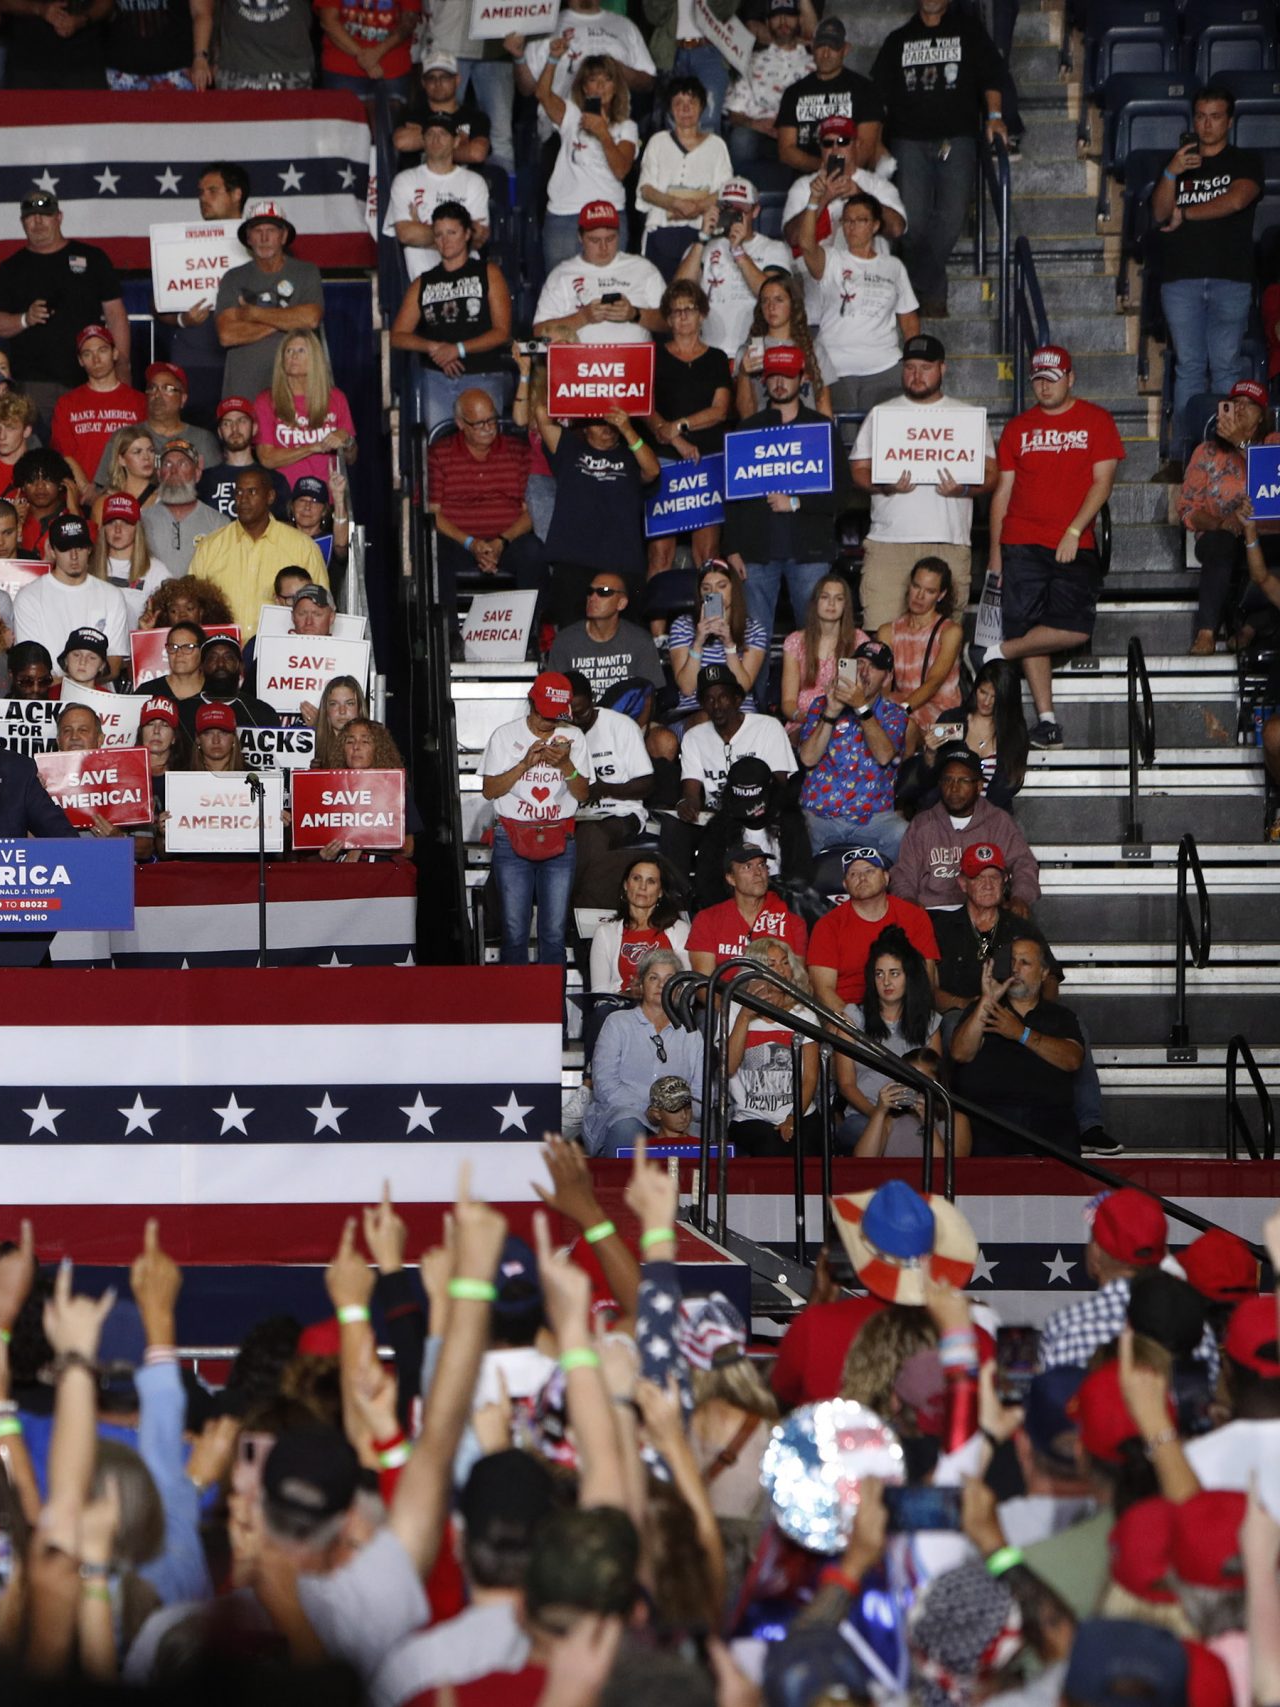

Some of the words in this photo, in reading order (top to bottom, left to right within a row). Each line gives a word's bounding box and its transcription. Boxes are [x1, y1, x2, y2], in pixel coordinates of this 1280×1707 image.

[481, 4, 552, 20] AMERICA!
[1212, 174, 1232, 187] GO
[186, 257, 230, 270] SAVE
[167, 277, 220, 291] AMERI
[577, 362, 625, 378] SAVE
[556, 382, 645, 398] AMERICA!
[70, 409, 96, 421] MAKE
[97, 410, 137, 421] AMERICA
[75, 422, 102, 434] GREAT
[281, 426, 337, 444] TRUM
[906, 427, 955, 441] SAVE
[1021, 429, 1089, 447] LaRose
[754, 441, 802, 459] SAVE
[885, 447, 975, 462] AMERICA!
[734, 459, 823, 481] AMERICA!
[669, 472, 709, 493] SAVE
[212, 482, 236, 499] JE
[218, 500, 238, 517] FO
[652, 491, 722, 517] AMERICA
[482, 610, 513, 622] SAVE
[465, 628, 523, 642] AMERICA!
[288, 655, 336, 669] SAVE
[576, 656, 596, 668] JUST
[597, 655, 620, 667] WANT
[621, 654, 632, 665] TO
[595, 667, 608, 678] MY
[609, 666, 628, 677] DOG
[266, 676, 326, 691] AMERI
[590, 678, 620, 689] RETEND
[145, 699, 174, 714] MAGA
[99, 714, 121, 727] VE
[8, 725, 42, 737] FOR
[240, 730, 314, 753] ACKS
[69, 768, 118, 787] SAVE
[51, 788, 142, 810] AMERICA!
[321, 790, 371, 806] SAVE
[732, 786, 763, 797] TRUMP
[200, 794, 250, 808] SAVE
[517, 800, 562, 820] TRUMP
[178, 815, 273, 830] AMERICA!
[300, 811, 394, 828] AMERICA!
[20, 900, 48, 908] 88022
[24, 913, 48, 921] OHIO
[718, 944, 743, 955] REAL
